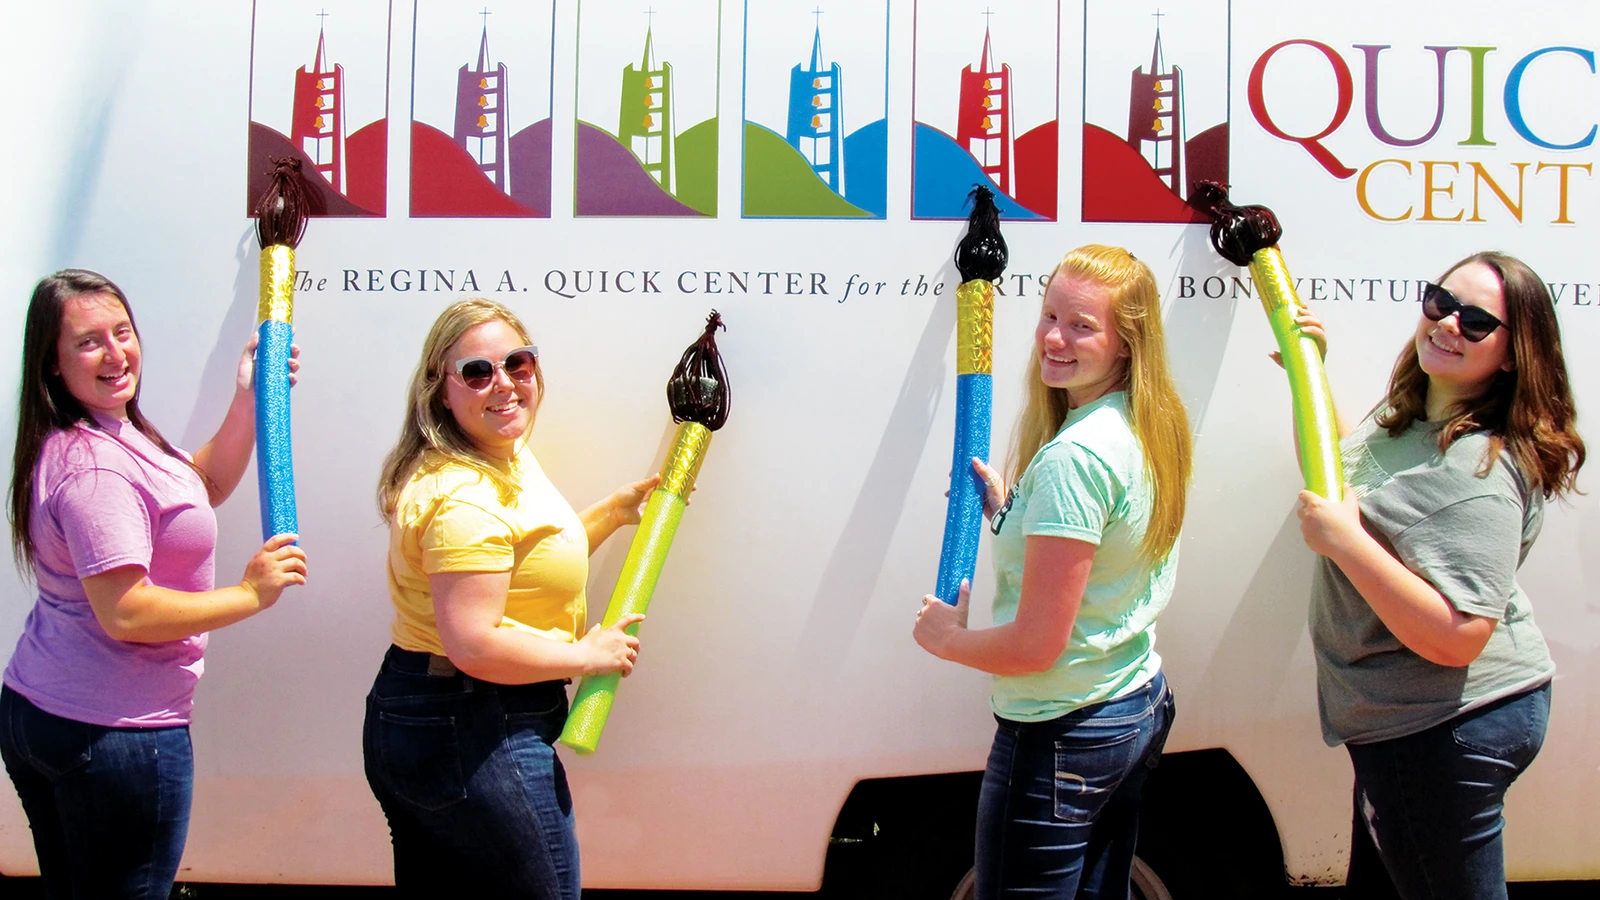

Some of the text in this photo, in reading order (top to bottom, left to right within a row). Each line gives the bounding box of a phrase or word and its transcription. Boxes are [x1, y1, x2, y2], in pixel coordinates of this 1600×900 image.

[1247, 38, 1598, 180] QUIC
[1355, 158, 1593, 224] CENT
[342, 269, 481, 293] REGINA
[495, 269, 529, 294] A.
[544, 270, 662, 299] QUICK
[677, 270, 830, 296] CENTER
[838, 273, 887, 304] for
[900, 274, 945, 297] the
[992, 273, 1050, 297] RTS
